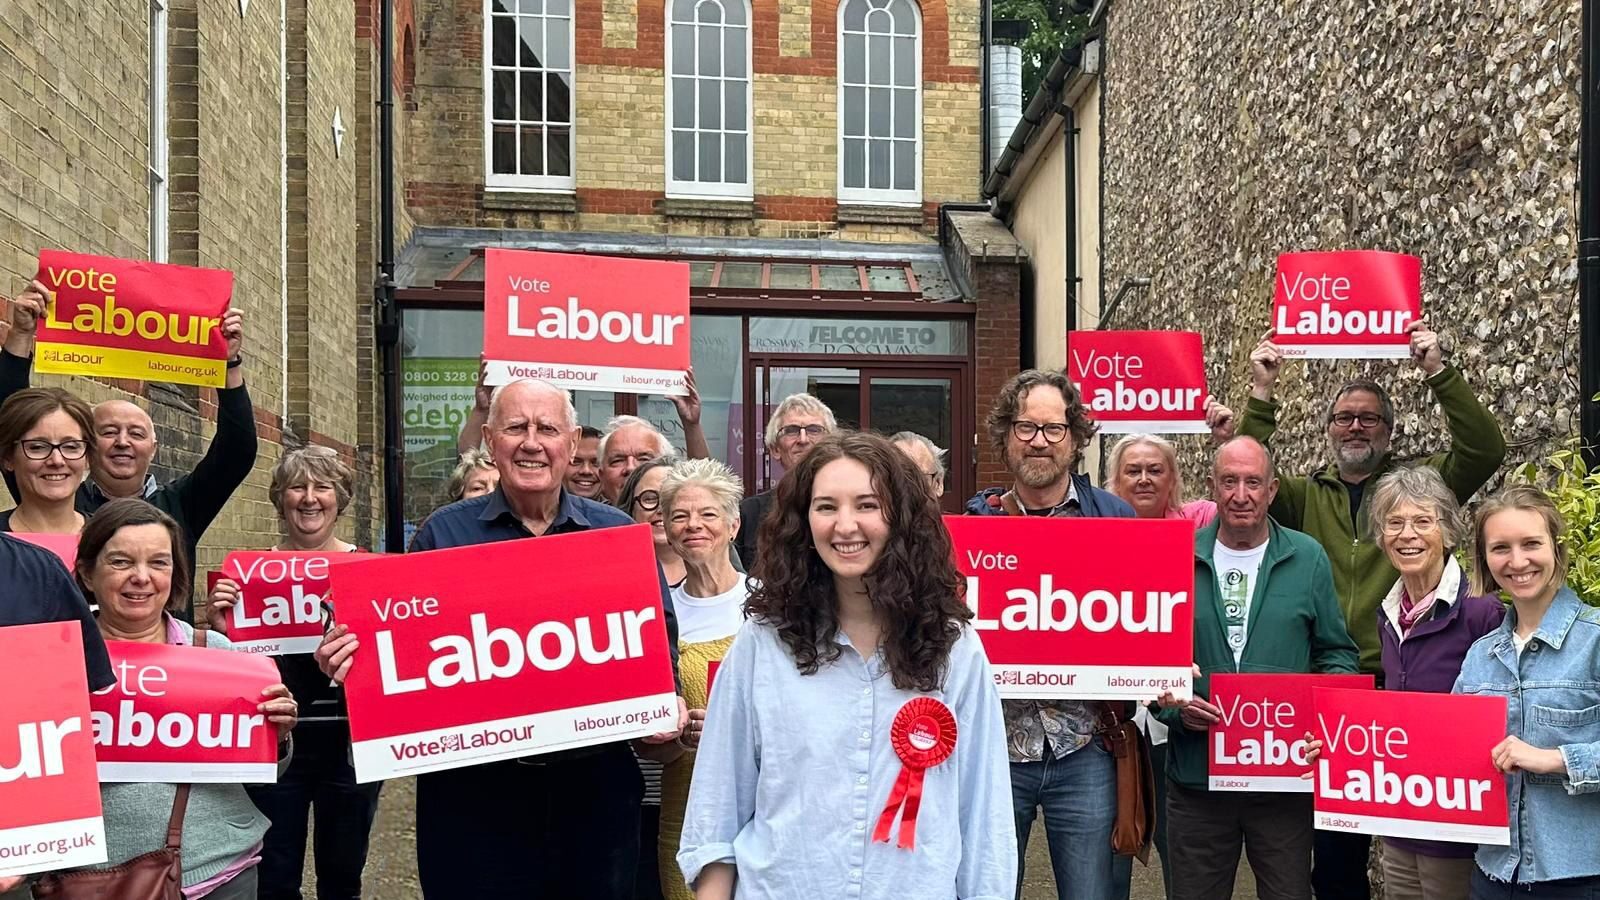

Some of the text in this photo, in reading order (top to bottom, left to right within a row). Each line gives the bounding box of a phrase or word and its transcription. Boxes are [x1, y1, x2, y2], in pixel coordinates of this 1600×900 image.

[508, 275, 551, 293] Vote
[1281, 271, 1350, 301] Vote
[45, 290, 220, 346] Labour
[507, 295, 685, 346] Labour
[1276, 303, 1412, 335] Labour
[906, 327, 936, 345] TO
[56, 350, 218, 378] Labour labour.org.uk
[404, 371, 440, 382] 0800
[443, 371, 467, 382] 328
[507, 366, 685, 388] Vote Labour labour.org.uk
[1073, 349, 1143, 379] Vote
[404, 393, 448, 402] Weighed
[232, 556, 330, 585] Vote
[968, 549, 1018, 571] Vote
[371, 596, 439, 622] Vote
[967, 574, 1187, 633] Labour
[246, 643, 281, 654] Labour
[375, 607, 656, 695] Labour
[1017, 671, 1077, 686] Labour
[1107, 675, 1186, 690] labour.org.uk
[573, 706, 671, 732] labour.org.uk
[1215, 694, 1295, 728] Vote
[390, 724, 535, 761] Vote Labour
[1318, 713, 1409, 759] Vote
[1221, 779, 1250, 788] Labour
[1318, 759, 1491, 811] Labour
[1329, 817, 1360, 829] Labour
